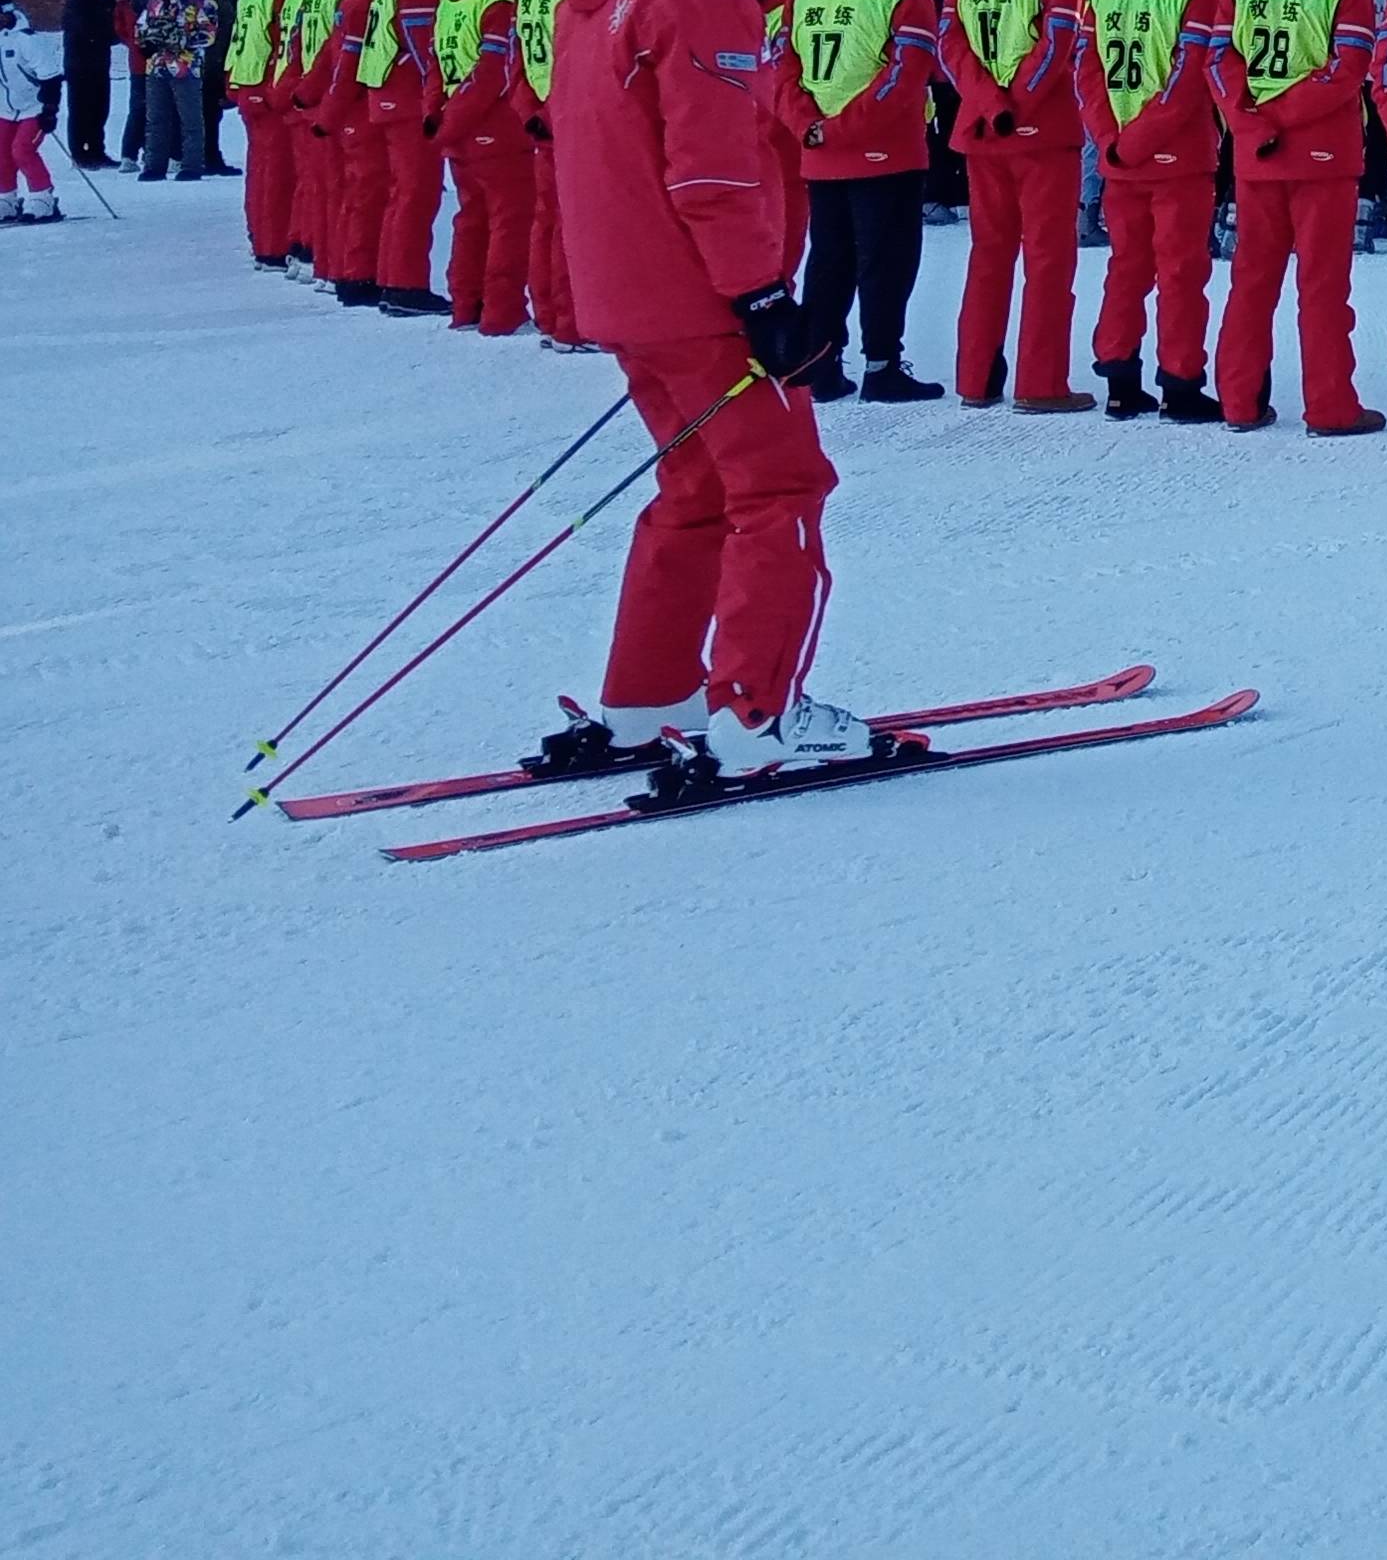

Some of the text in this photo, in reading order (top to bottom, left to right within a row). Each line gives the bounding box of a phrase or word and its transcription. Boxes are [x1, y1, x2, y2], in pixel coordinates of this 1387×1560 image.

[804, 4, 855, 26] 教练
[811, 31, 843, 83] 17
[1106, 37, 1144, 93] 26
[1247, 27, 1290, 79] 28
[795, 742, 847, 753] ATOMIC
